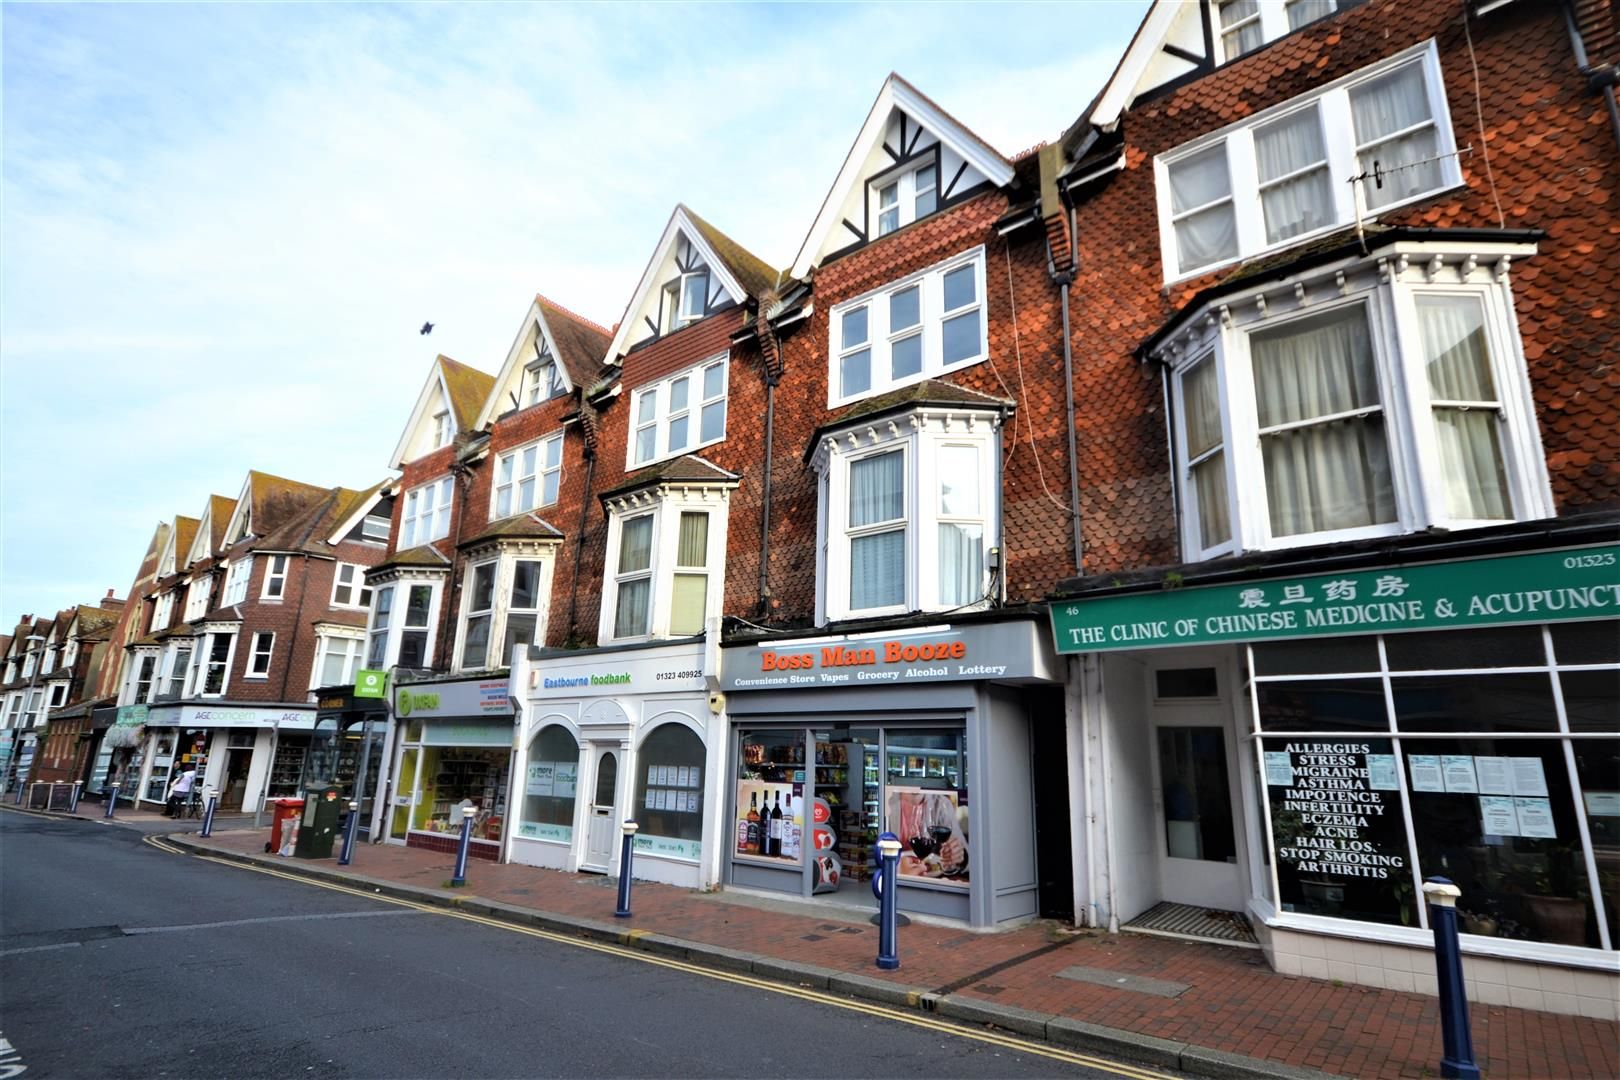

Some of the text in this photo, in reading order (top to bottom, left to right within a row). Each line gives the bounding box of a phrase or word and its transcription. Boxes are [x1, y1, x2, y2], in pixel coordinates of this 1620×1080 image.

[1563, 553, 1616, 569] 01323
[1238, 575, 1410, 609] 震旦药房
[1066, 606, 1079, 616] 46
[1069, 584, 1620, 644] THE CLINIC OF CHINESE MEDICINE & ACUPUNCT
[761, 640, 966, 672] Boss Man Booze
[544, 672, 632, 689] Eastbourne foodbank
[656, 670, 703, 681] 01323 409925
[734, 664, 1007, 686] Convenience Store Vapes Grocery Alcohol Lottery
[1285, 743, 1370, 754] ALLERGIES
[1300, 755, 1356, 766] STRESS
[1291, 766, 1369, 778] MIGRAINE
[1297, 778, 1365, 790] ASTHMA
[1285, 789, 1382, 803] IMPOTENCE
[1284, 801, 1385, 816] INFERTILITY
[1301, 813, 1369, 827] ECZEMA
[1315, 827, 1359, 839] ACNE
[1296, 837, 1381, 853] HAIR LOS
[1280, 848, 1404, 867] STOP SMOKING
[1297, 861, 1388, 879] ARTHRITIS
